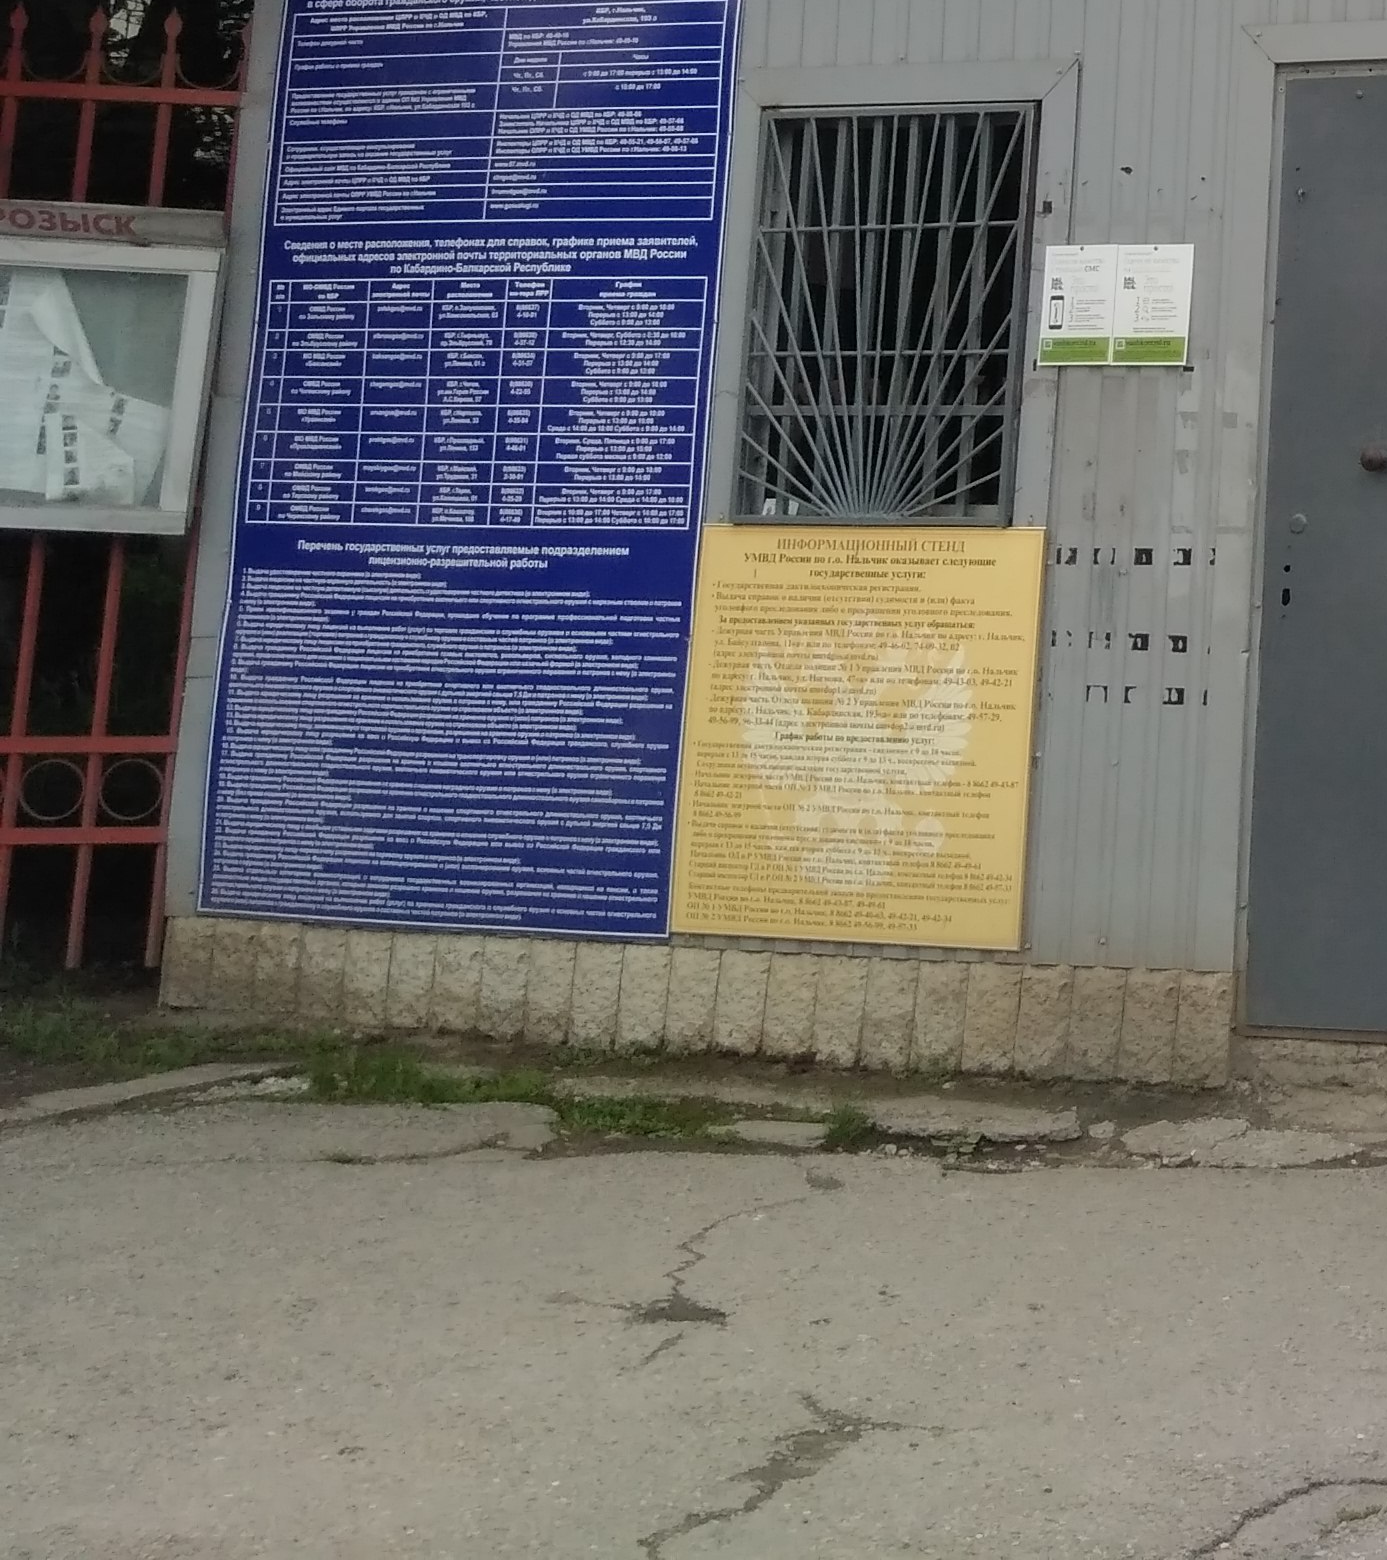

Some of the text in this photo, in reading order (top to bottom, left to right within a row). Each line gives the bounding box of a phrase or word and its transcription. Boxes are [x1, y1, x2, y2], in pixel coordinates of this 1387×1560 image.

[306, 0, 312, 8] в
[284, 240, 327, 251] Сведения
[337, 241, 363, 249] месте
[364, 241, 431, 251] расположения,
[434, 238, 484, 250] телефонах
[486, 240, 505, 250] для
[507, 240, 549, 249] справок,
[552, 237, 594, 249] графике
[596, 239, 634, 249] приема
[637, 236, 699, 248] заявителей,
[292, 249, 687, 263] официальных адресов электронной почты территориальных органов МВД России
[390, 262, 571, 275] по Кабардино-Балкарской Республике
[298, 540, 630, 557] Перечень государственных услуг предоставляемые подразделением
[776, 538, 965, 554] ИНФОРМАЦИОННЫЙ СТЕНД
[368, 554, 548, 570] лицензионно-разрешительной работы
[743, 553, 997, 568] УМВД России по г.о. Нальчик оказывает следующие
[808, 568, 926, 580] государственные услуги:
